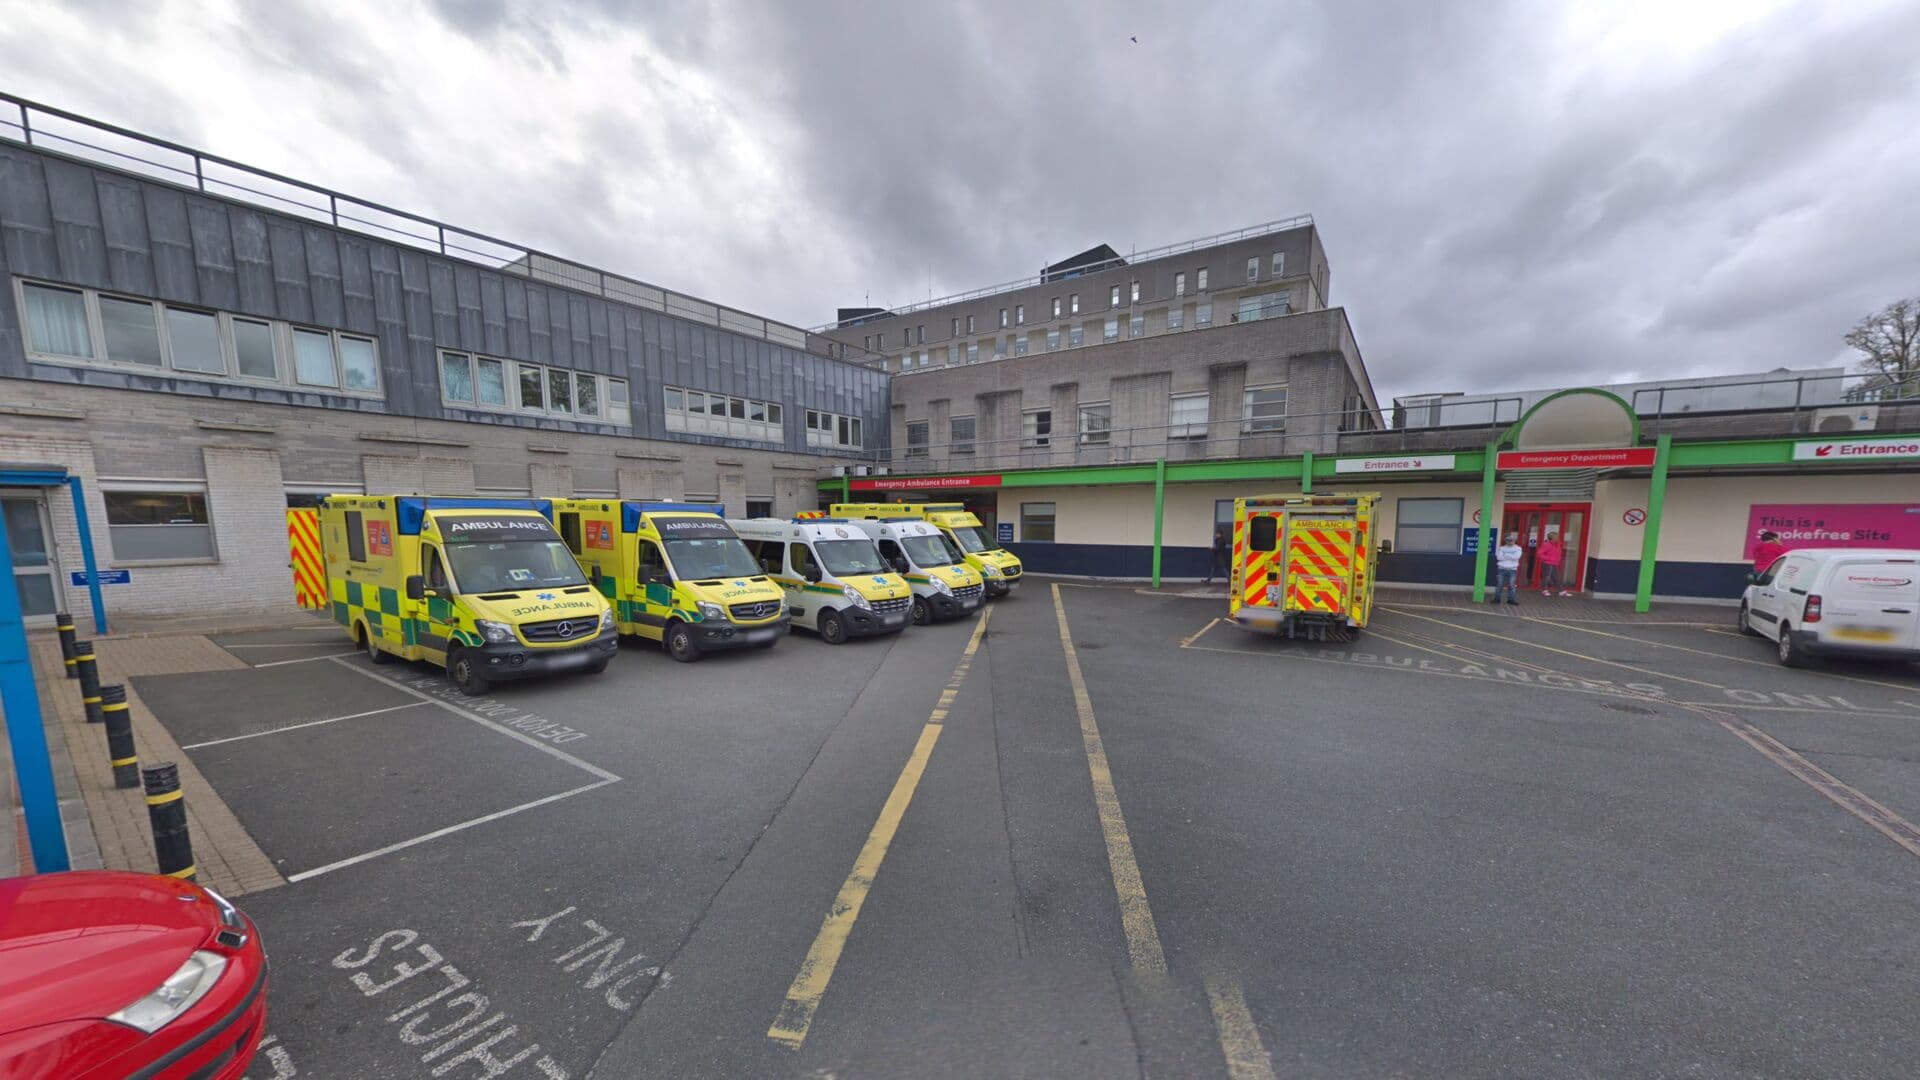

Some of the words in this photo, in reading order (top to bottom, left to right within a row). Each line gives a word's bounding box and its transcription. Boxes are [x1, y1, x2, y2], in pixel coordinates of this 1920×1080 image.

[1840, 444, 1919, 455] Entrance
[1521, 455, 1569, 464] Emergency
[1571, 453, 1627, 462] Department
[1364, 461, 1409, 469] Entrance
[875, 480, 906, 489] Emergency
[906, 479, 940, 487] Ambulance
[941, 478, 970, 486] Entrance
[451, 521, 549, 532] AMBULANCE
[666, 522, 728, 530] AMBULANCE
[1295, 520, 1348, 528] AMBULANCE
[1760, 517, 1794, 527] This
[1798, 517, 1812, 527] is
[1757, 528, 1850, 540] Sokefree
[1854, 529, 1891, 540] Site
[511, 906, 673, 1012] ONLY
[332, 929, 570, 1080] HICLES
